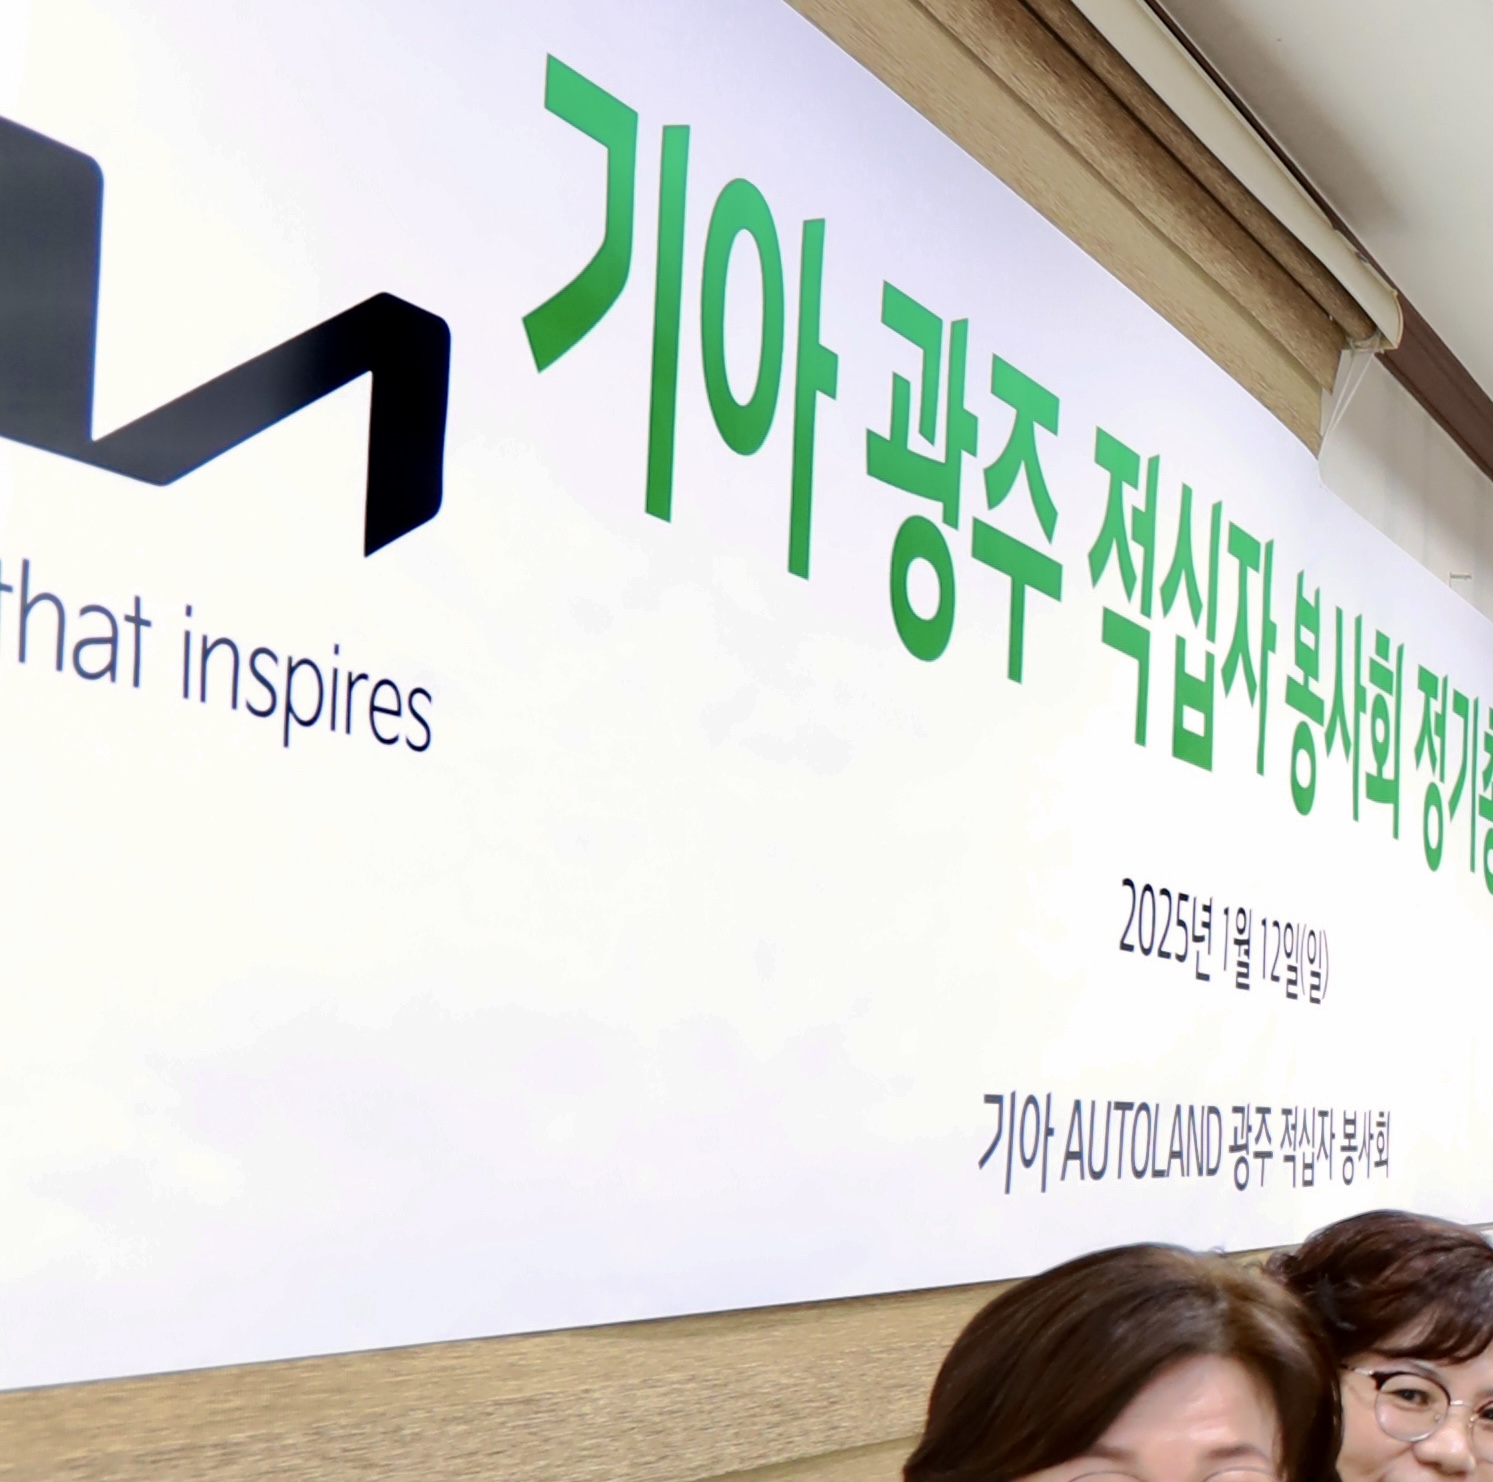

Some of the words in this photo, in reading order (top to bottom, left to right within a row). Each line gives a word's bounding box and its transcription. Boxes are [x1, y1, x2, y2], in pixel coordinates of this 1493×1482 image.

[522, 53, 838, 581] 기아
[866, 280, 1063, 685] 광주
[1088, 425, 1277, 777] 적십자
[1285, 569, 1405, 840] 봉사회
[183, 604, 433, 753] inspires
[1119, 877, 1213, 982] 2025년
[1223, 906, 1252, 991] 1월
[1261, 916, 1329, 1005] 12일(일)
[978, 1090, 1055, 1195] 기아
[1060, 1099, 1222, 1181] AUTOLAND
[1229, 1103, 1273, 1192] 광주
[1280, 1105, 1335, 1188] 적십자
[1340, 1110, 1391, 1186] 봉사회
